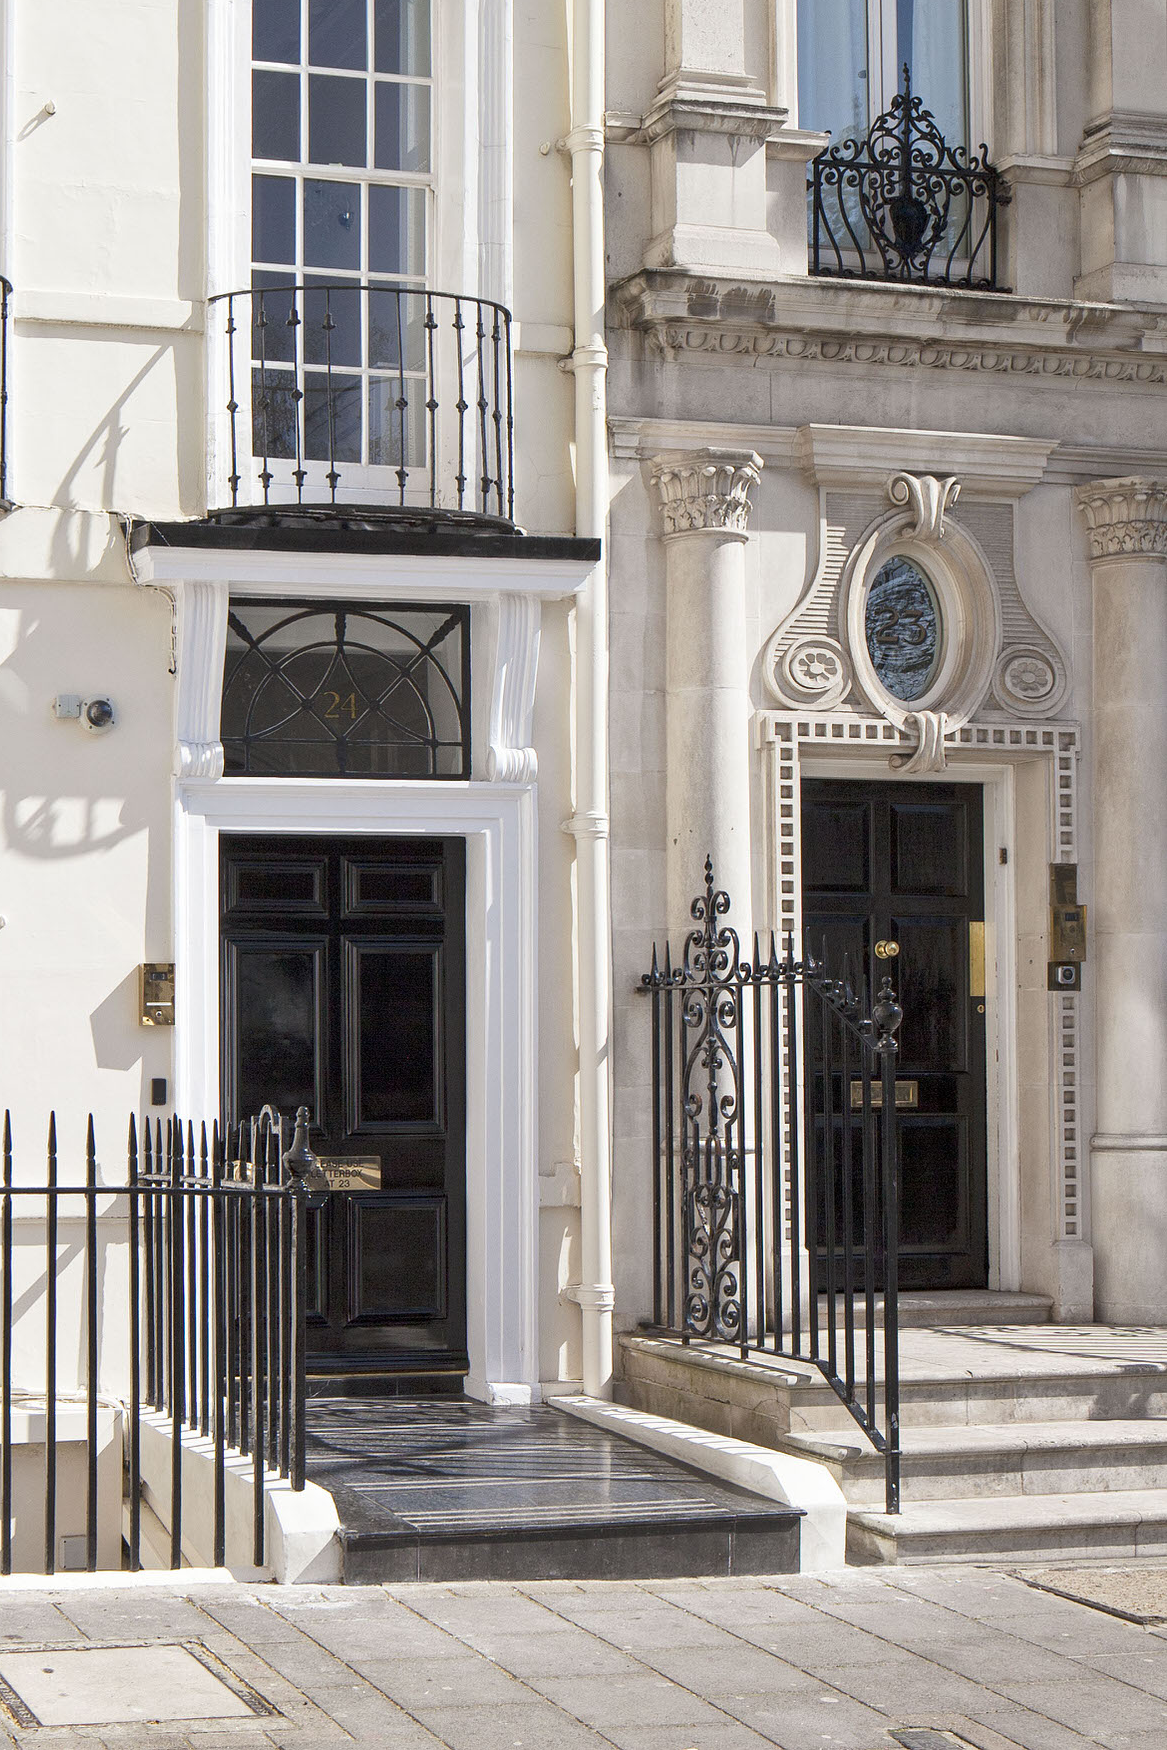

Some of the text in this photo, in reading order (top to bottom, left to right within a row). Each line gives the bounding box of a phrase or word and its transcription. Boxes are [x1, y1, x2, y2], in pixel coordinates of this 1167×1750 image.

[874, 607, 927, 645] 23
[323, 691, 358, 719] 24
[318, 1159, 364, 1168] LEASE USE
[310, 1169, 363, 1178] LETTERBOX
[338, 1179, 351, 1188] 23
